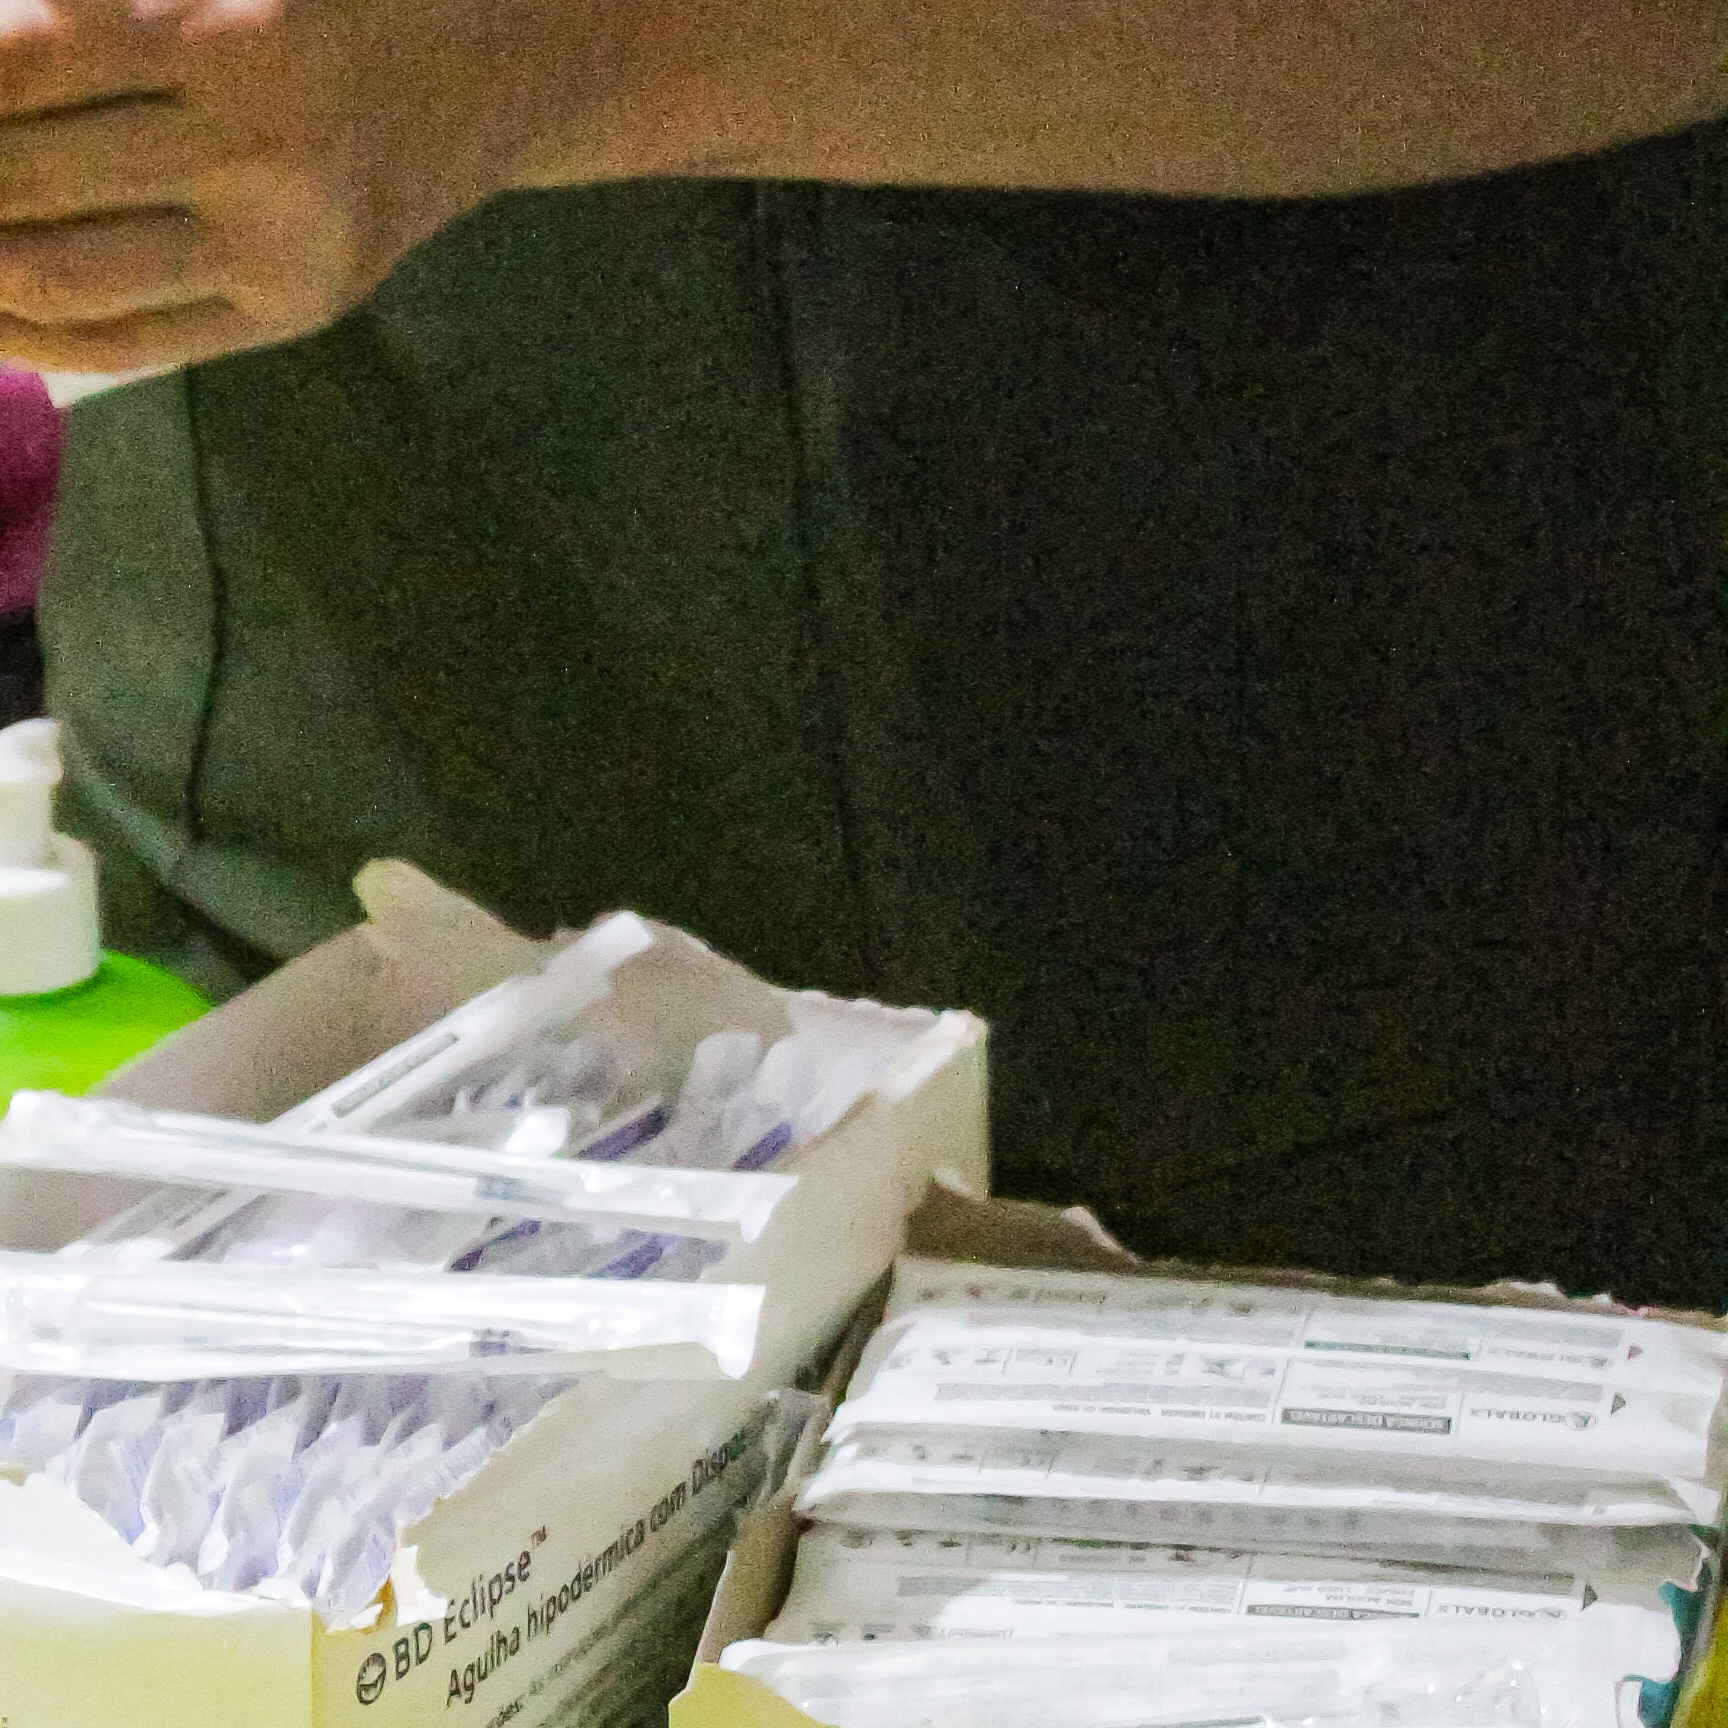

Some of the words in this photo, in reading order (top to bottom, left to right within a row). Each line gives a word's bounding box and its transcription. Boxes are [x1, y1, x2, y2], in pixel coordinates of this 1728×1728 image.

[394, 1622, 433, 1681] BD
[446, 1626, 520, 1709] Agulha
[527, 1518, 645, 1640] hipodérmica
